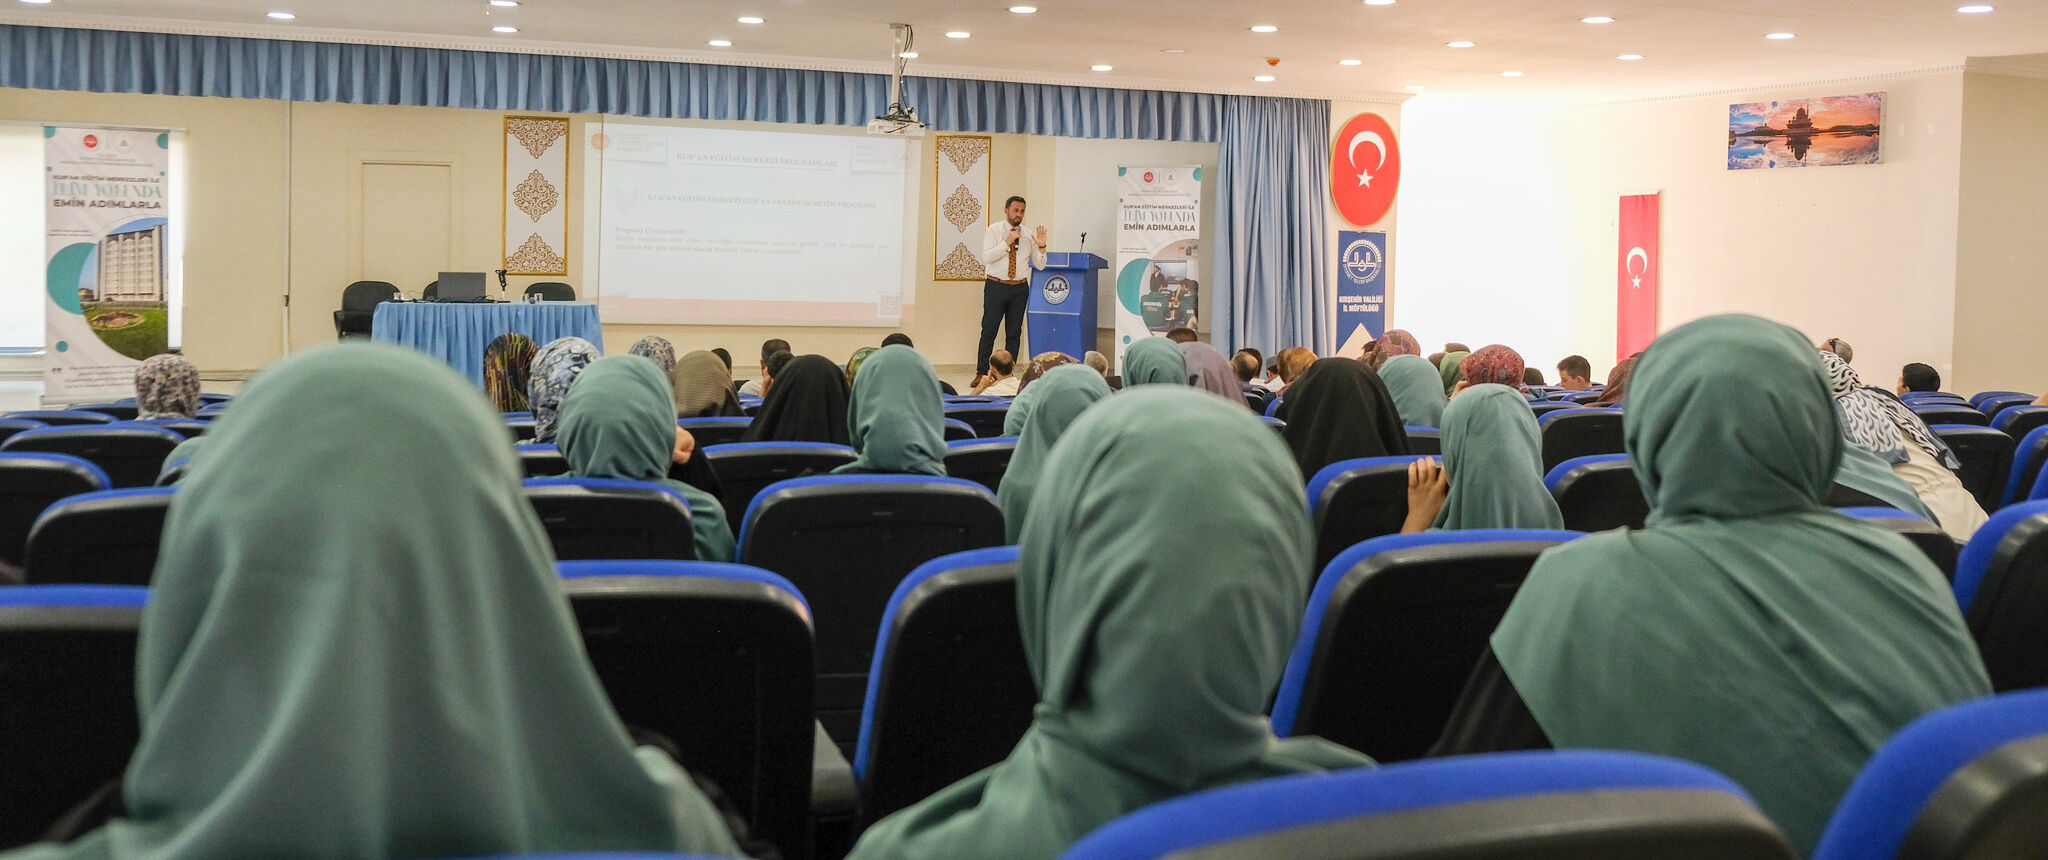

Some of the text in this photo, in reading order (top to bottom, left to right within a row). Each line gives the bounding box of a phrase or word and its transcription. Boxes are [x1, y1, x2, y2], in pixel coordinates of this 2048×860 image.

[54, 197, 161, 209] EMİN ADIMLARLA
[1124, 222, 1196, 232] EMİN ADIMLARLA
